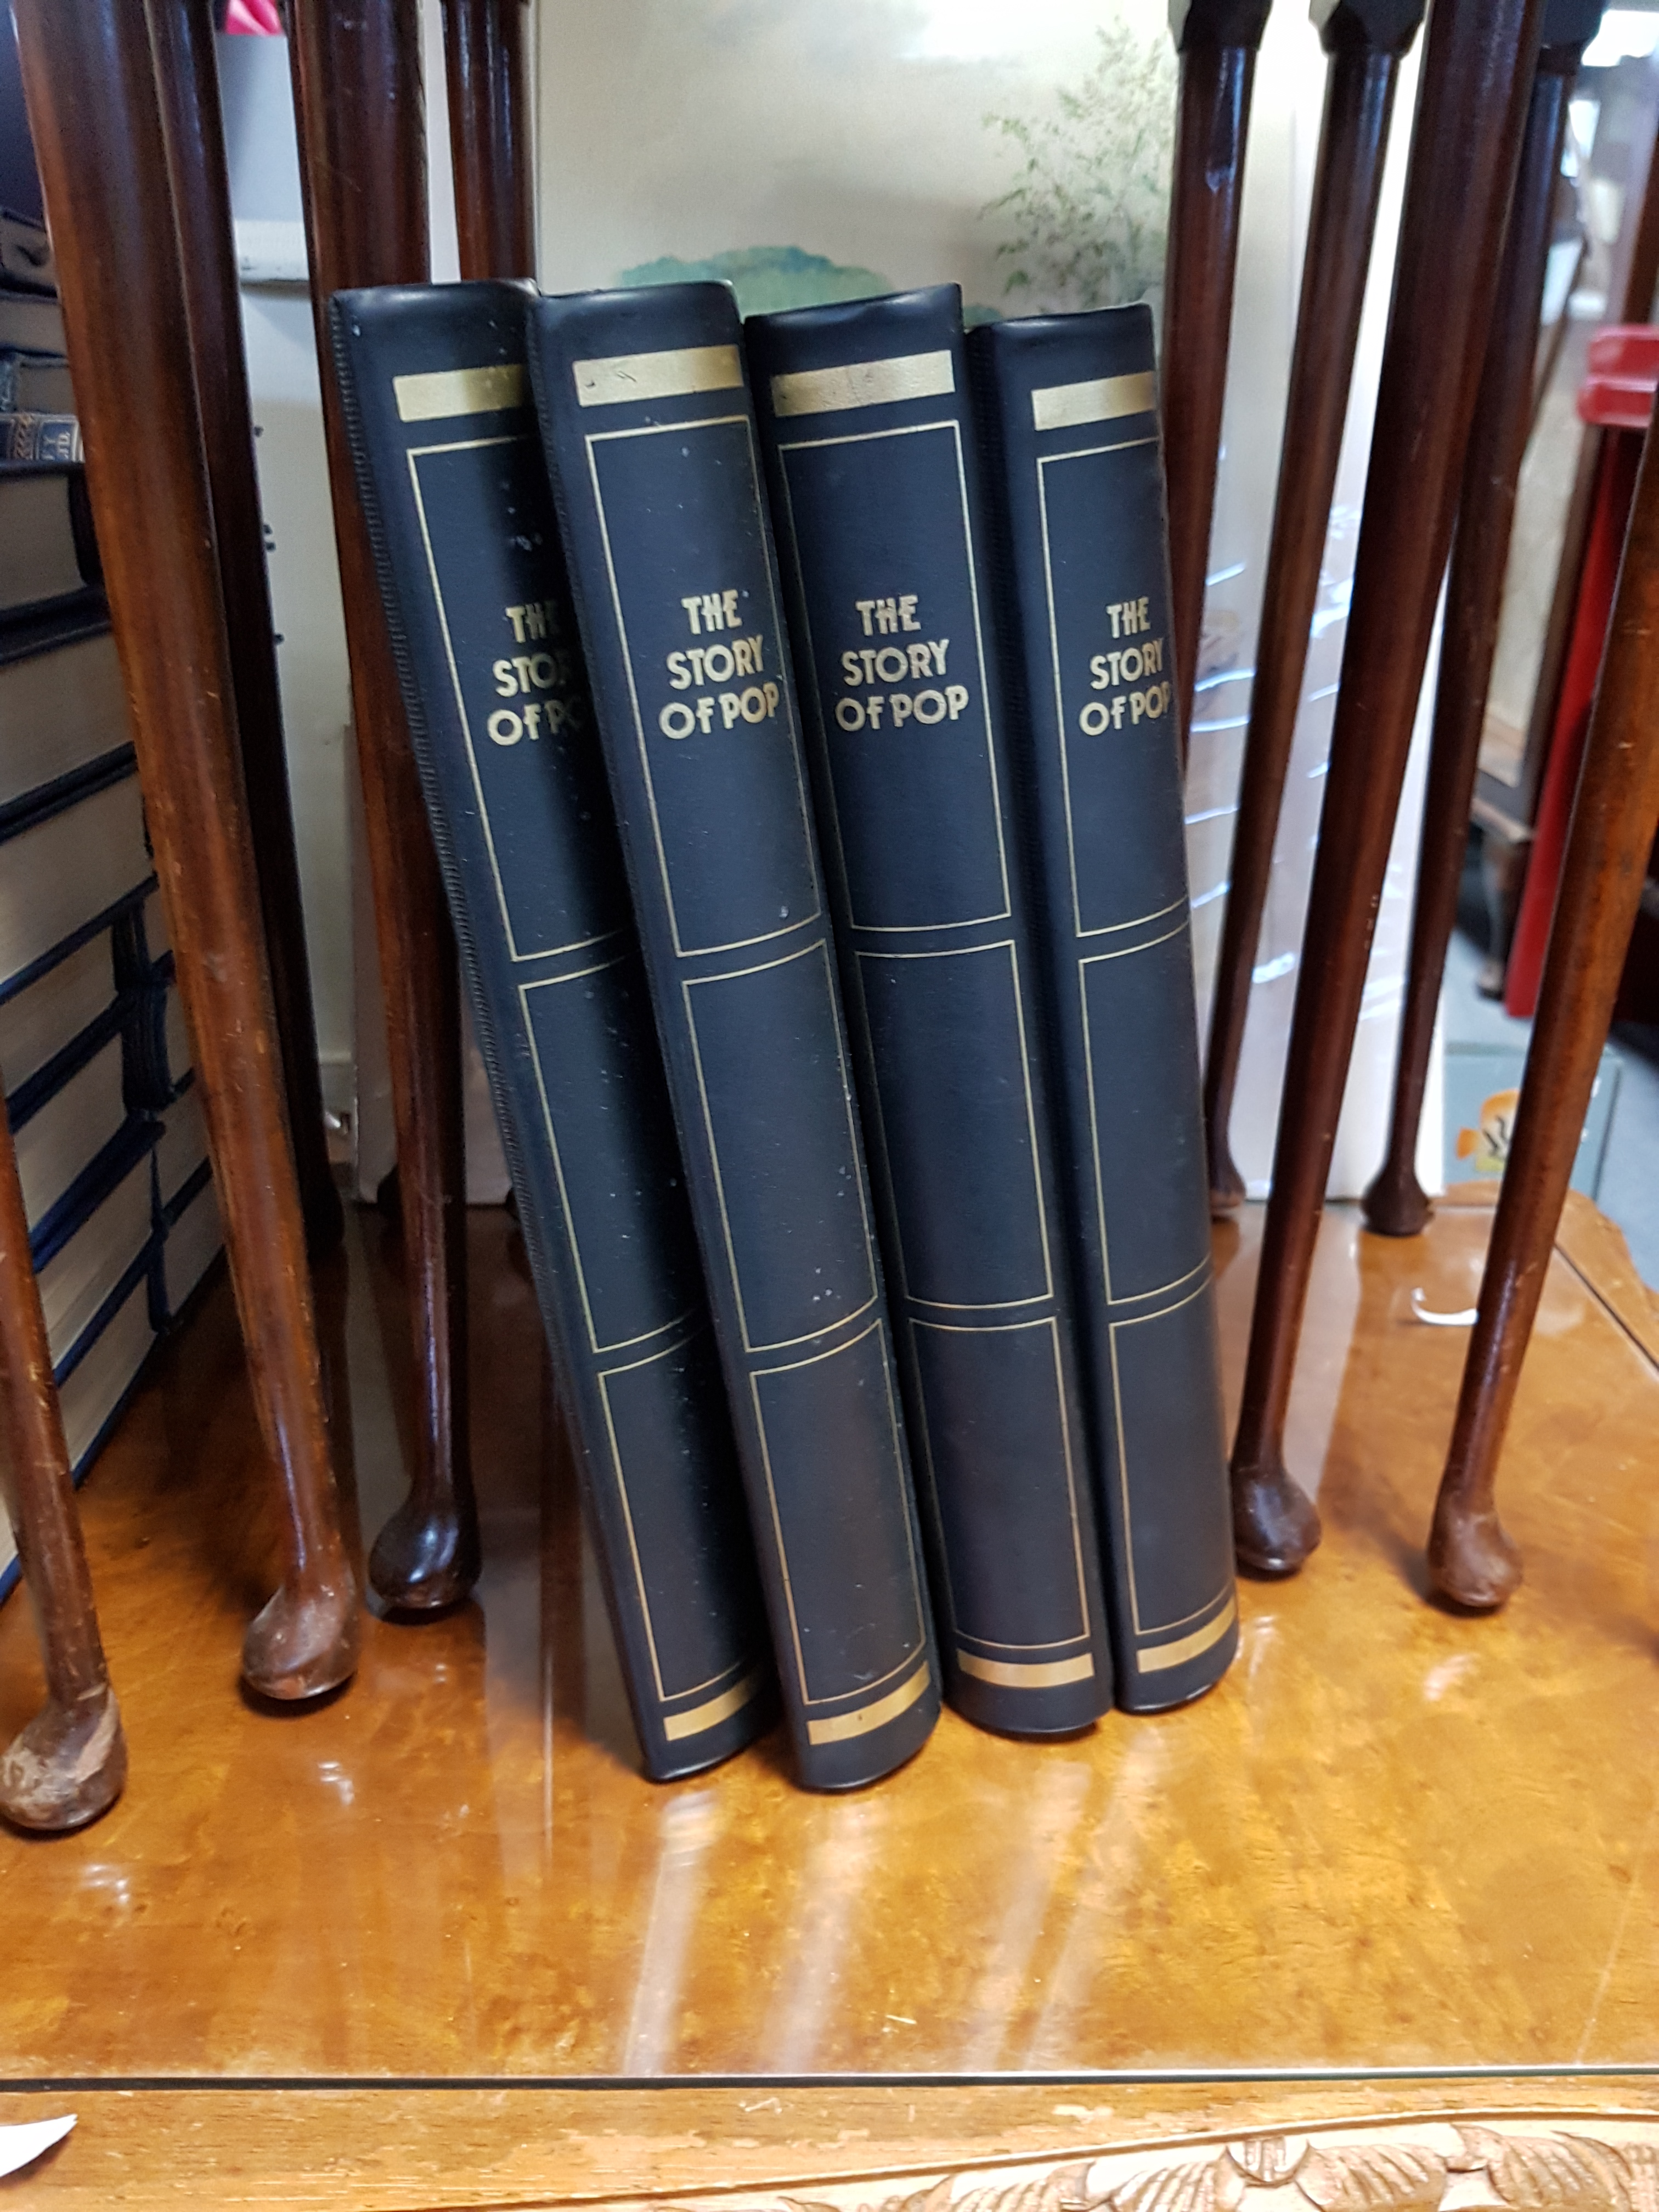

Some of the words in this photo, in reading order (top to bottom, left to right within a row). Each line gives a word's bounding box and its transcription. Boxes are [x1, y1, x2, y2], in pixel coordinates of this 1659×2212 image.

[681, 589, 742, 635] THE
[855, 595, 921, 636] THE
[1106, 596, 1150, 639] THE
[493, 651, 568, 697] STO
[667, 634, 764, 690] STORY
[842, 639, 949, 686] STORY
[1090, 637, 1163, 690] STORY
[487, 703, 542, 747] OF
[659, 697, 715, 739] OF
[719, 682, 779, 729] POP
[835, 696, 885, 731] OF
[889, 685, 969, 727] POP
[1079, 696, 1126, 736] OF
[1129, 681, 1171, 725] POP
